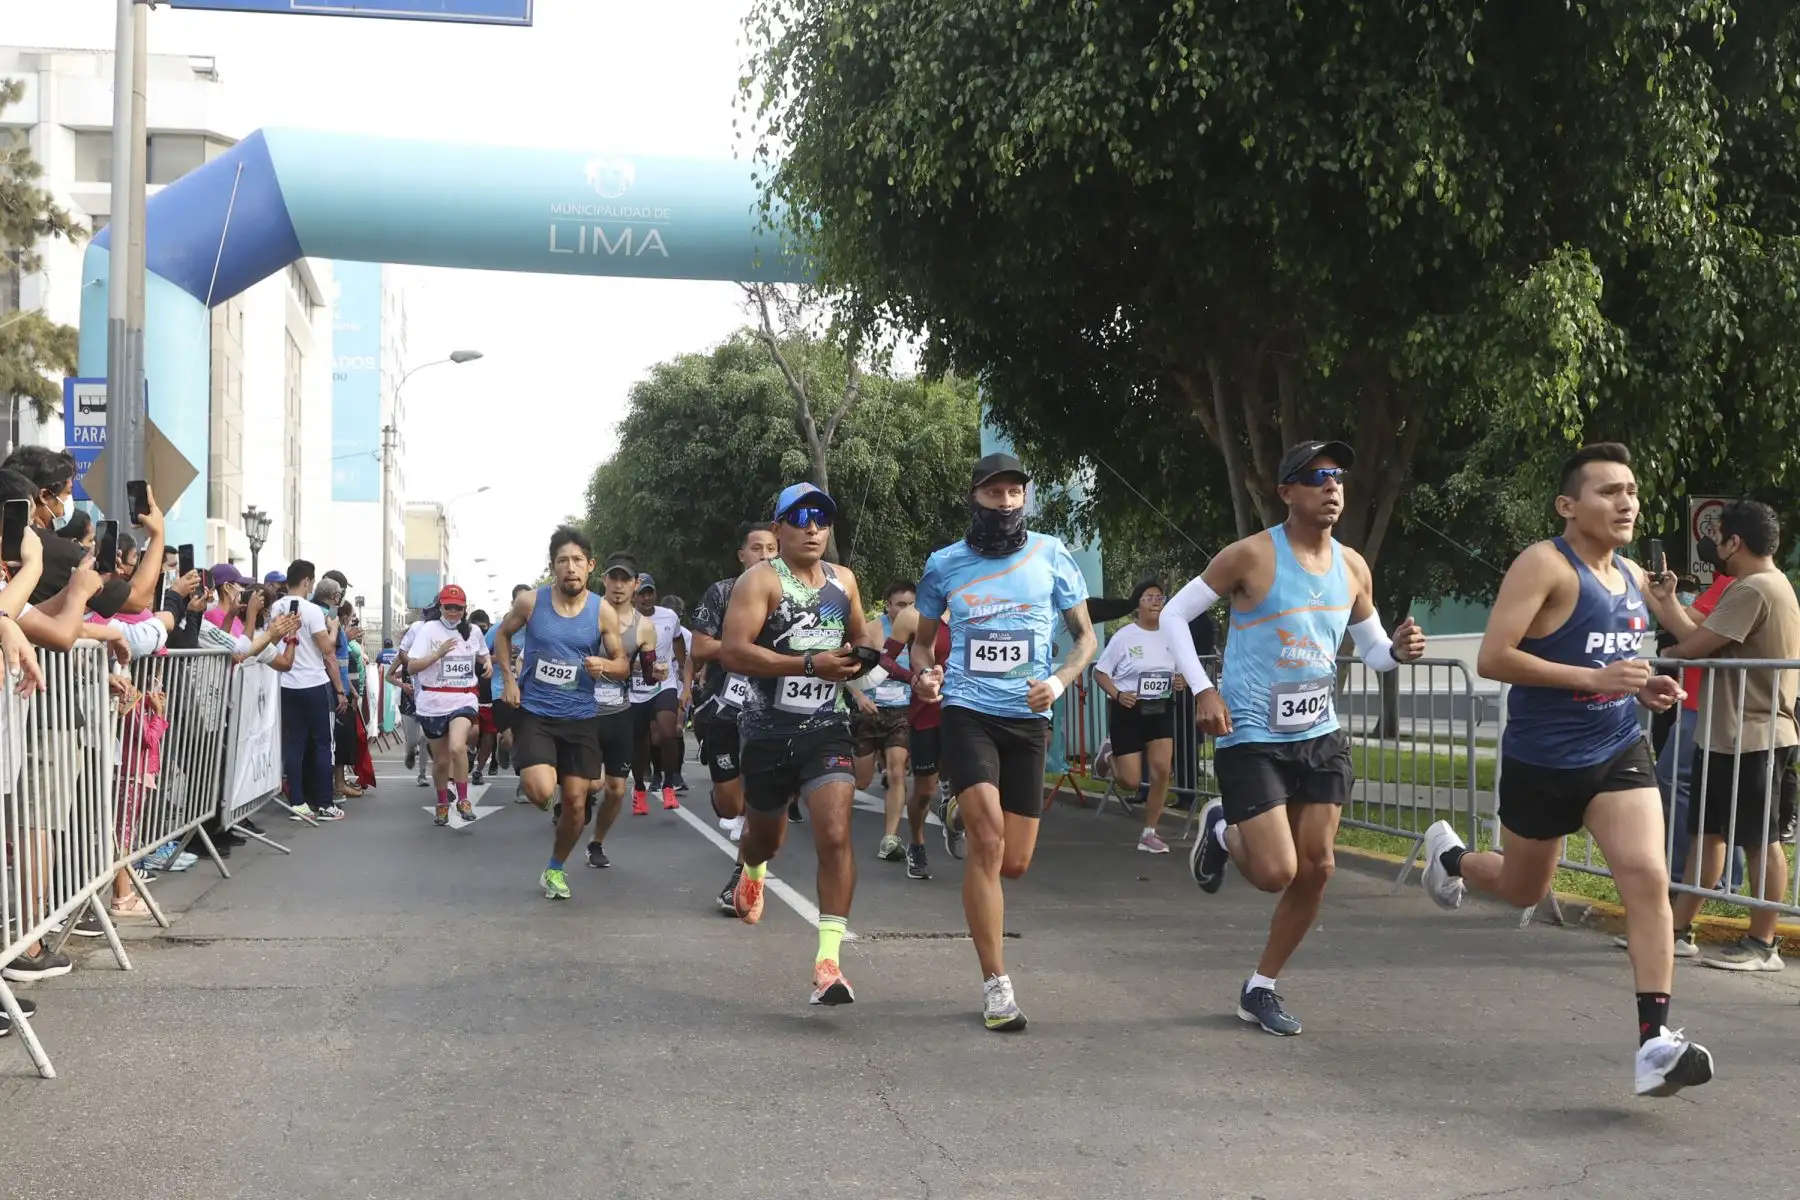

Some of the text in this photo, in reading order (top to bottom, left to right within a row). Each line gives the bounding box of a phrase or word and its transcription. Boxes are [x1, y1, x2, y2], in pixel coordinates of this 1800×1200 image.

[550, 203, 672, 219] MUNICIPALIDAD DE
[549, 224, 669, 257] LIMA
[74, 427, 107, 443] PARA
[1692, 562, 1715, 573] CICL
[1585, 632, 1644, 654] PERU
[975, 645, 1021, 662] 4513
[445, 664, 470, 673] 3466
[540, 665, 573, 680] 4292
[635, 679, 646, 687] 54
[730, 683, 746, 697] 49
[786, 681, 834, 700] 3417
[1143, 681, 1168, 691] 6027
[1281, 694, 1326, 718] 3402
